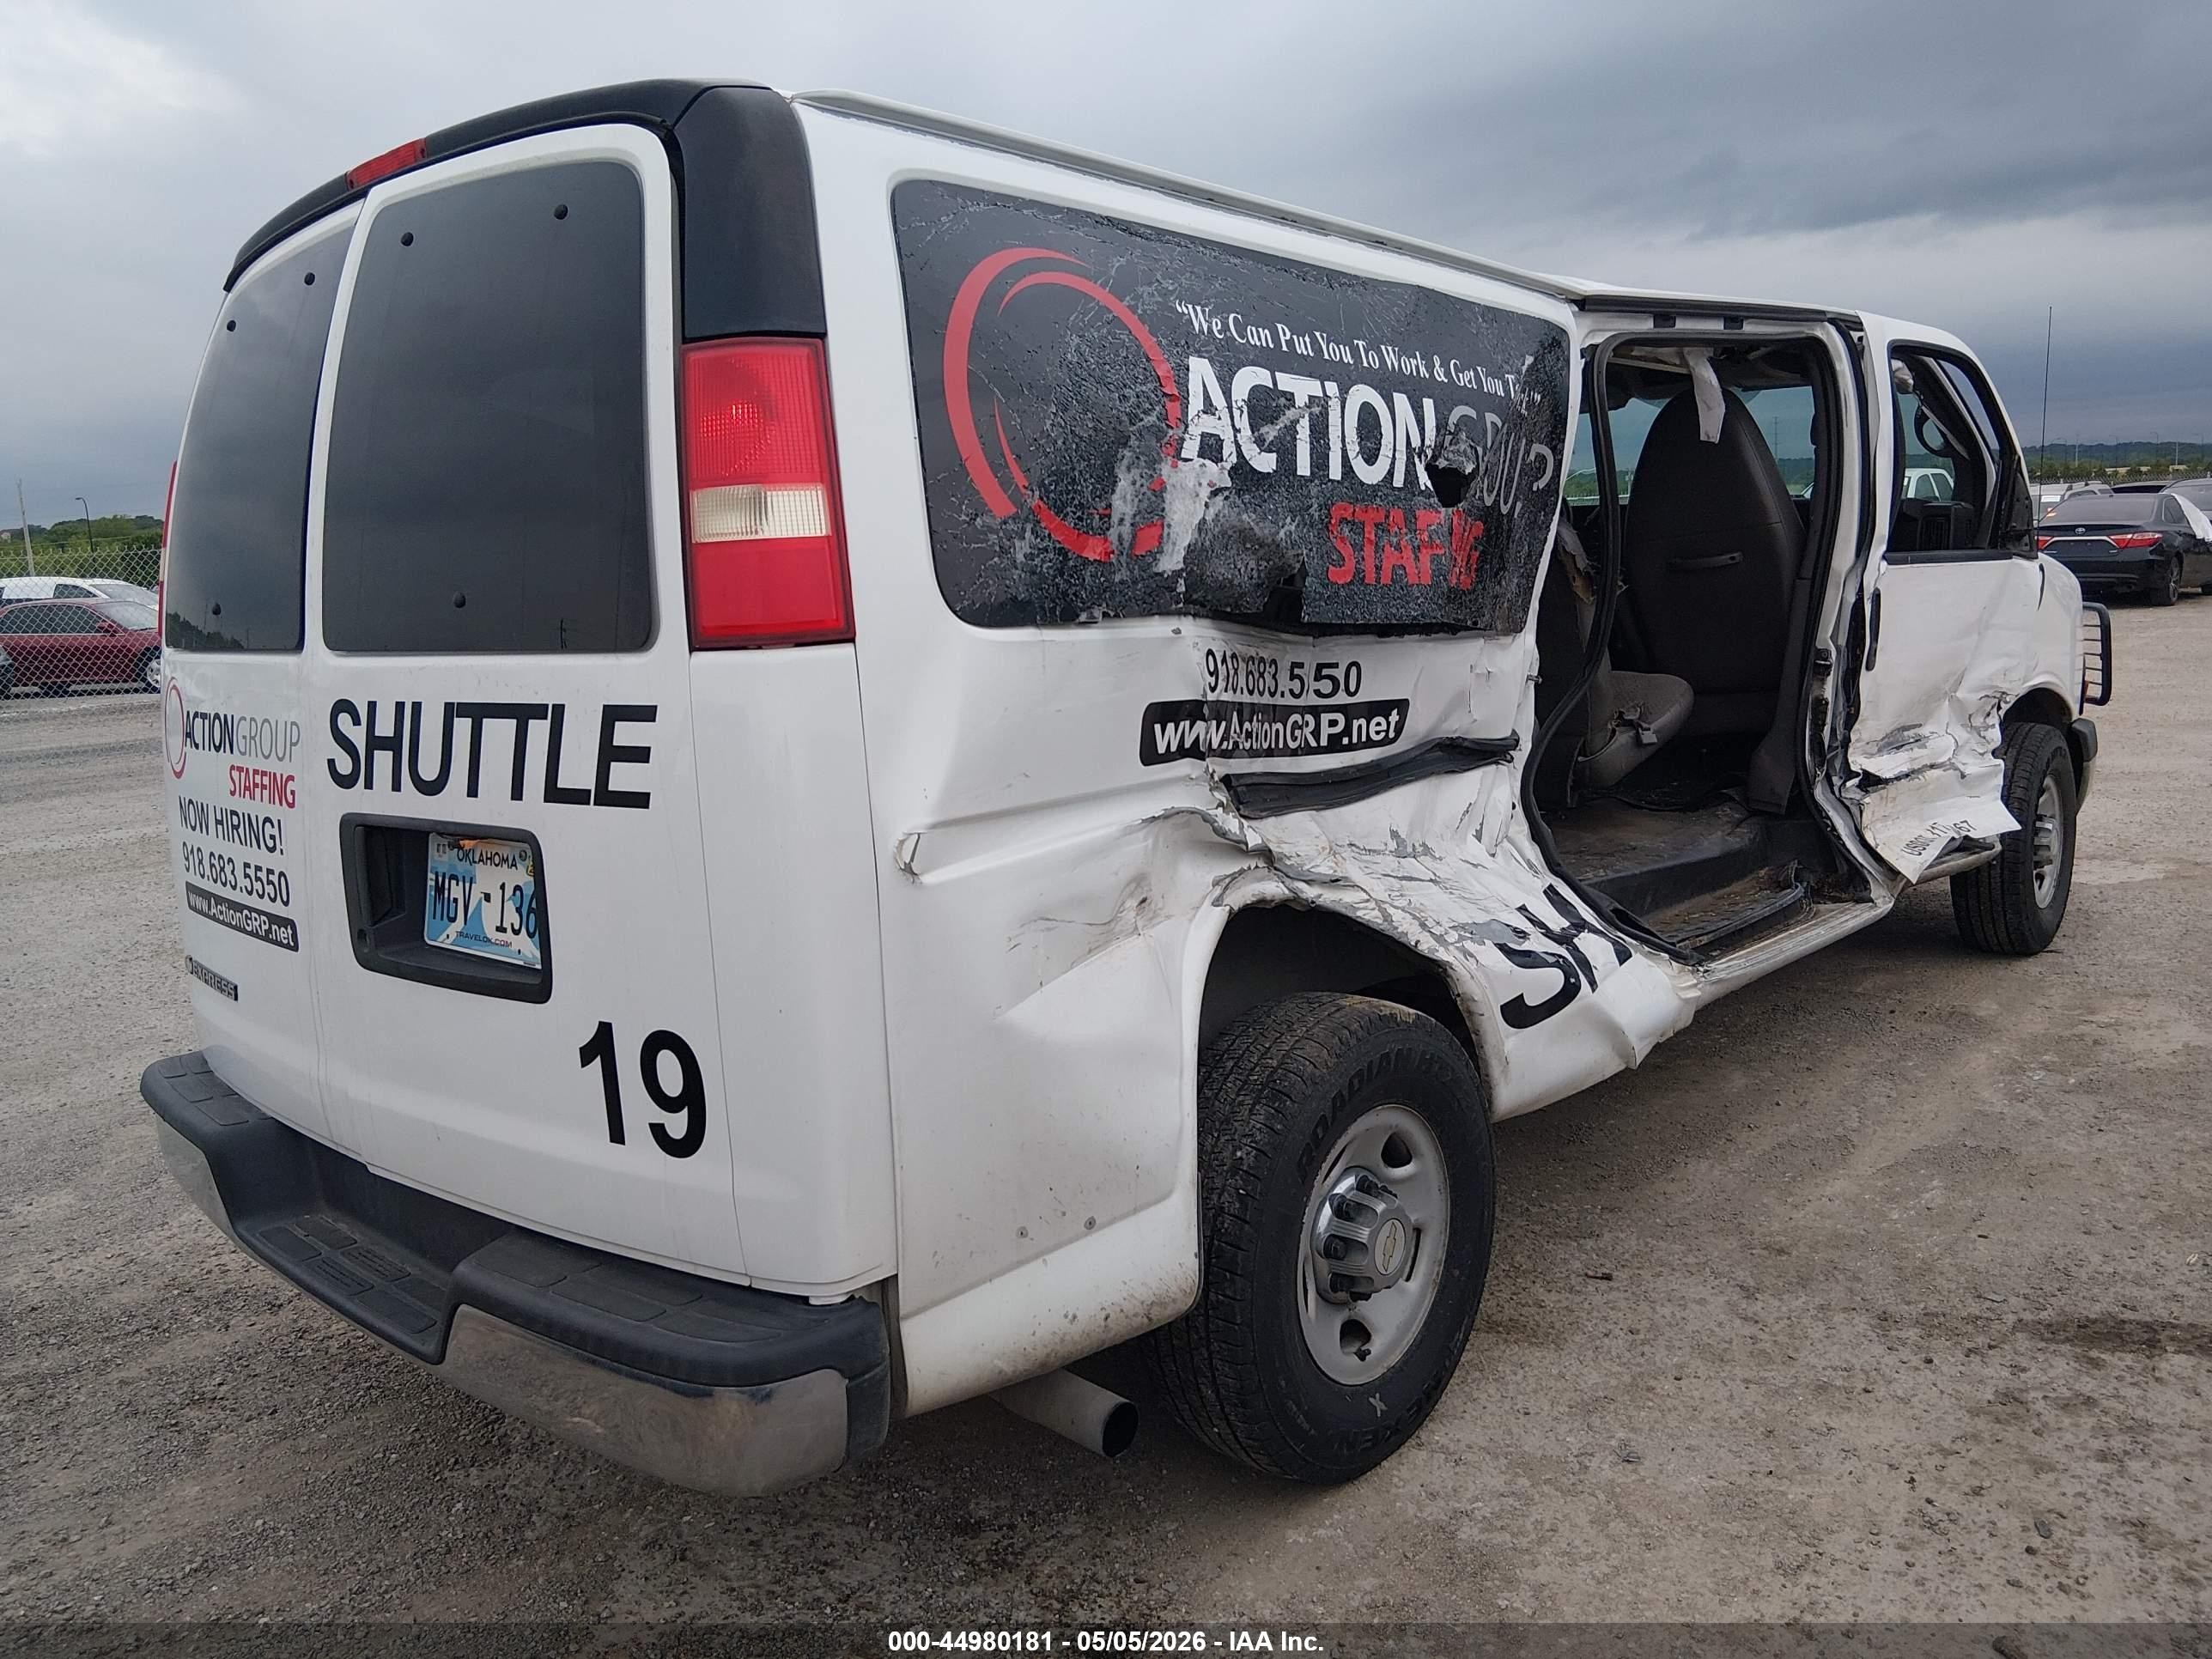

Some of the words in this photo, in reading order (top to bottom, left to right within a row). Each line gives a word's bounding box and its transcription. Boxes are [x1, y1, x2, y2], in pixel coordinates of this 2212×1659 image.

[1228, 313, 1274, 349] Can
[1275, 322, 1315, 357] Put
[1313, 331, 1354, 365] You
[1353, 339, 1379, 370] To
[1380, 344, 1429, 380] Work
[1433, 354, 1448, 384] &
[1449, 358, 1478, 390] Get
[1476, 365, 1504, 398] You
[1205, 647, 1363, 700] 918.683.550
[326, 698, 658, 810] SHUTTLE
[228, 763, 296, 810] STAFFING
[179, 795, 210, 836] NOW
[213, 805, 284, 856] HIRING!
[182, 841, 290, 908] 918.683.5550
[456, 848, 519, 871] OKLAHOMA
[187, 890, 295, 947] www.ActionGRP.net
[455, 930, 513, 949] TRAVELOK.COM
[192, 961, 236, 1001] EXPRESS
[579, 1020, 707, 1159] 19
